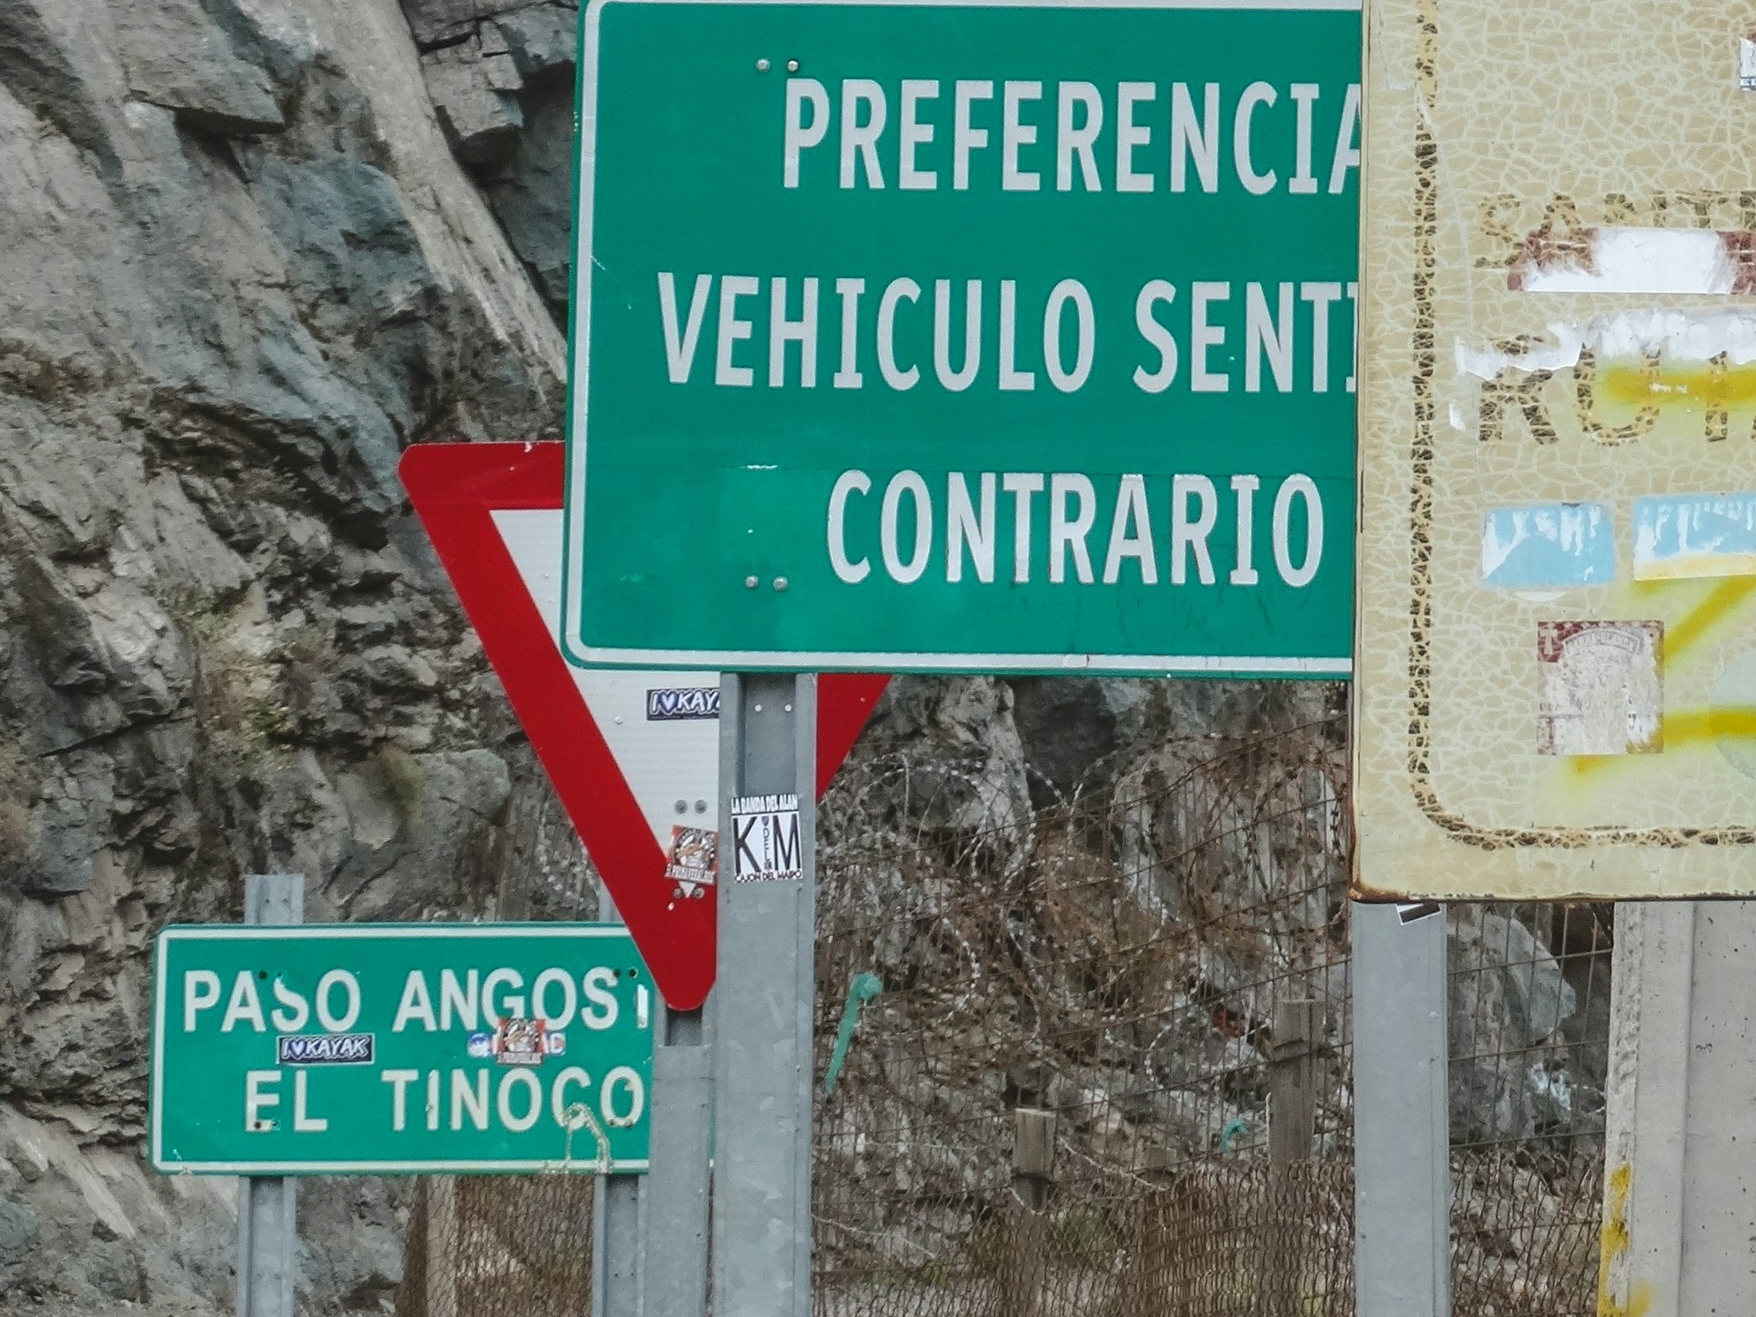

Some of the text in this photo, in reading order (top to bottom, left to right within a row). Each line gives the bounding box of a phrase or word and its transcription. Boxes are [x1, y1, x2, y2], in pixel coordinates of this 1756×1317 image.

[657, 271, 1097, 393] VEHICULO
[826, 469, 1325, 588] CONTRARIO
[182, 968, 362, 1034] PASO
[304, 1036, 369, 1059] KAYAK
[244, 1065, 645, 1133] EL TINOCO
